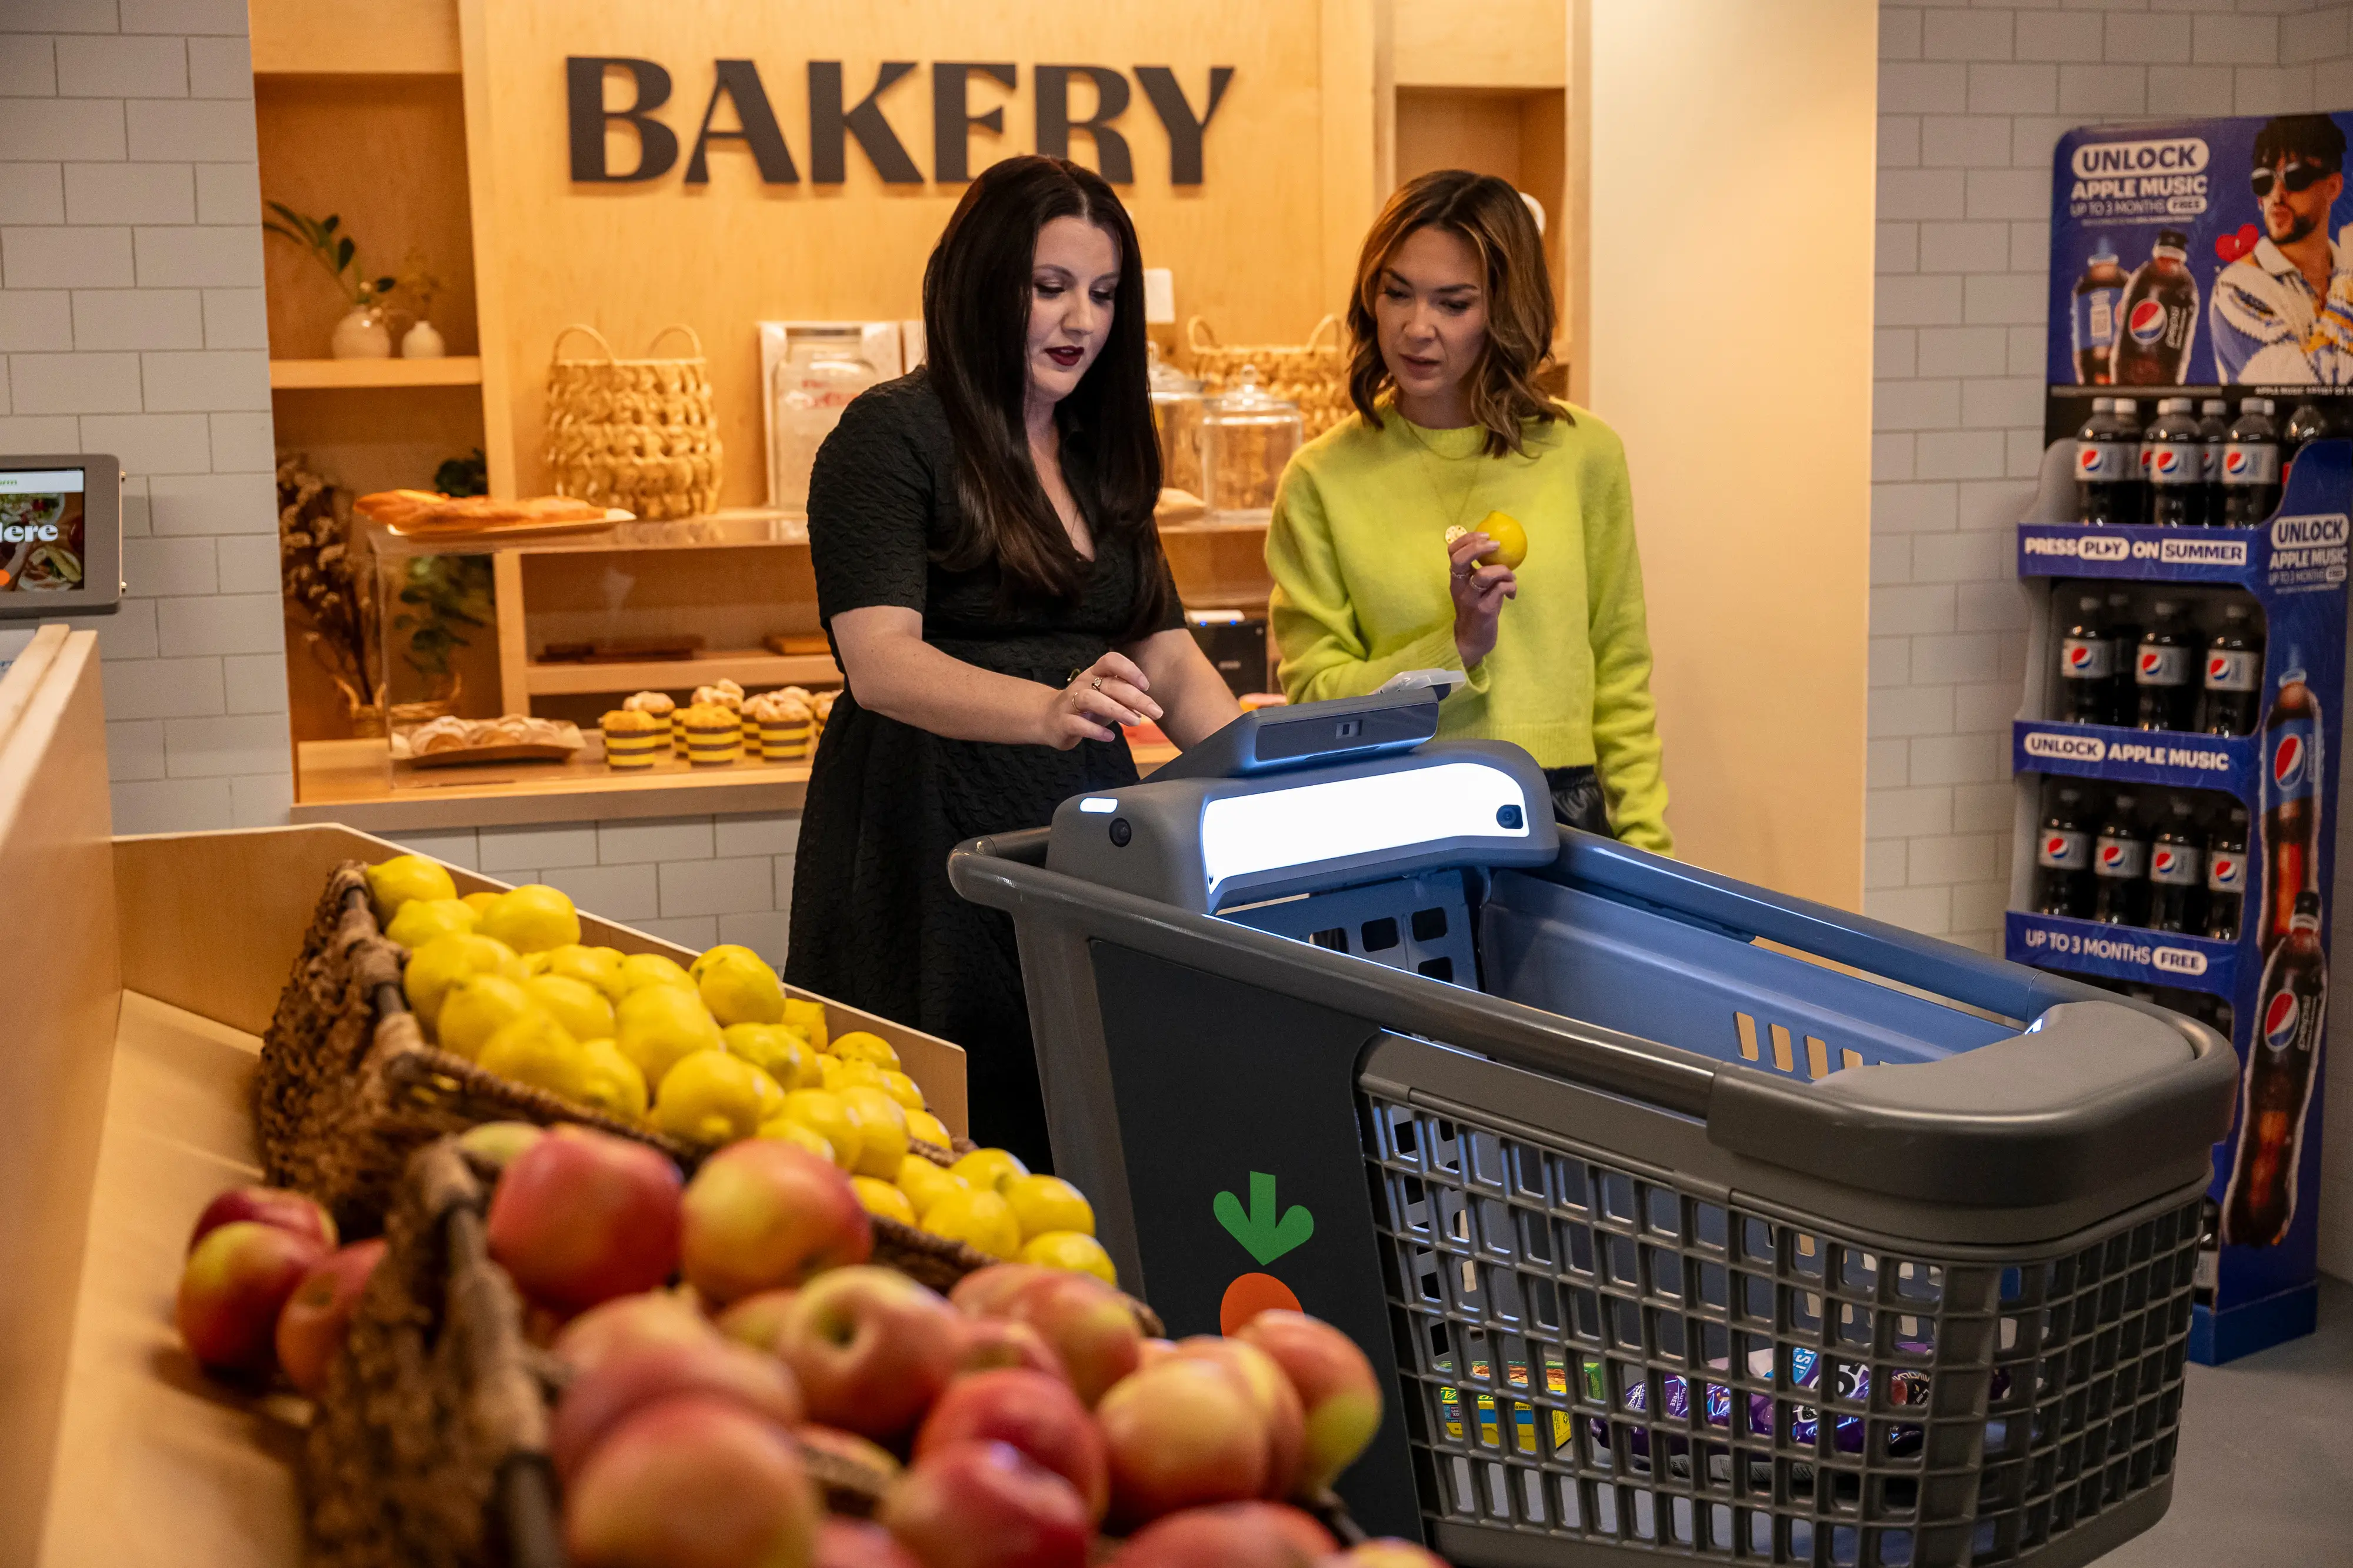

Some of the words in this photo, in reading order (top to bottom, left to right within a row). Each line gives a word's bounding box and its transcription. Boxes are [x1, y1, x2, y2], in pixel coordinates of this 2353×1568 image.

[566, 56, 1235, 185] BAKERY
[2082, 145, 2197, 172] UNLOCK
[2070, 179, 2137, 201] APPLE
[2139, 174, 2209, 197] MUSIC
[0, 521, 59, 543] ere
[2277, 519, 2343, 543] UNLOCK
[2025, 537, 2078, 556] PRESS
[2132, 541, 2159, 559] ON
[2165, 543, 2243, 560] SUMMER
[2269, 551, 2309, 570] APPLE
[2311, 546, 2348, 567] MUSIC
[2031, 738, 2098, 756] UNLOCK
[2108, 743, 2166, 765] APPLE
[2168, 748, 2229, 772] MUSIC
[2025, 928, 2047, 948] UP
[2049, 932, 2069, 952] TO
[2071, 935, 2081, 954] 3
[2083, 938, 2151, 965] MONTHS
[2161, 952, 2199, 969] FREE
[1669, 1392, 1678, 1407] FREE
